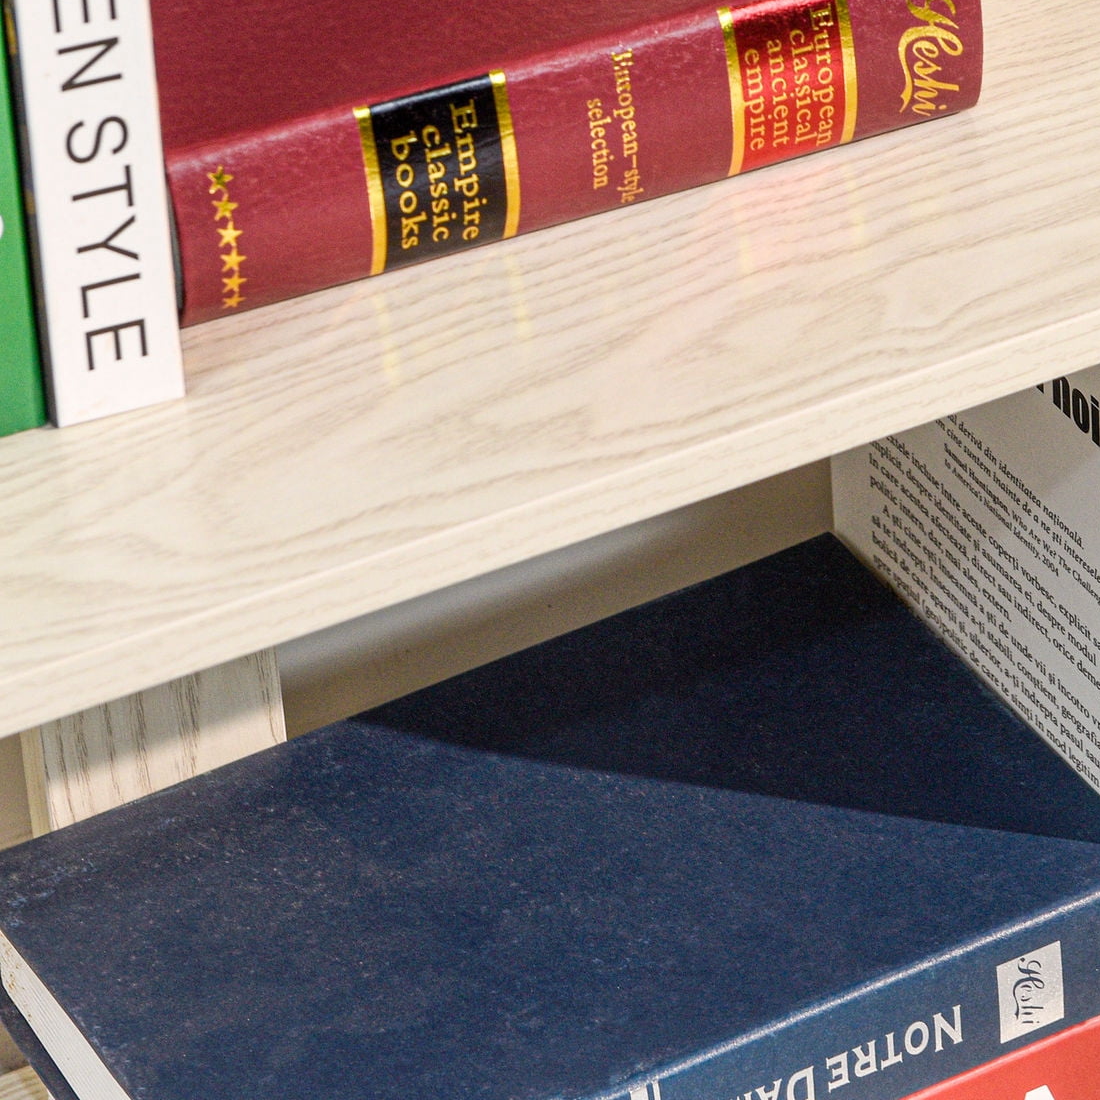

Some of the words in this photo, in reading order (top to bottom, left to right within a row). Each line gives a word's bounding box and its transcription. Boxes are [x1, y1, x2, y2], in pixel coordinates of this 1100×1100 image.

[744, 48, 764, 152] empire
[766, 39, 791, 148] ancient
[789, 29, 816, 144] classical
[809, 5, 834, 147] European
[390, 130, 427, 250] books
[422, 124, 457, 242] classic
[450, 99, 488, 242] Empire
[587, 97, 610, 189] selection
[66, 115, 149, 372] STYLE
[869, 475, 897, 505] politic
[958, 420, 982, 450] derivă
[998, 460, 1041, 508] identitatea
[963, 445, 991, 477] suntem
[880, 466, 898, 487] care
[900, 484, 929, 517] acestea
[971, 554, 996, 587] direct
[1052, 638, 1074, 664] orice
[903, 526, 921, 548] cine
[1010, 635, 1032, 662] unde
[905, 468, 932, 501] despre
[933, 495, 971, 542] identitate
[981, 548, 1022, 594] asumarea
[1036, 600, 1065, 635] despre
[1067, 631, 1096, 666] modul
[961, 508, 987, 538] aceste
[1058, 603, 1091, 641] explicit
[1041, 554, 1058, 577] 2004
[911, 572, 928, 594] care
[1059, 722, 1083, 752] pasul
[981, 664, 999, 686] care
[1068, 746, 1099, 787] legitim
[737, 1066, 815, 1100] DA
[825, 1004, 963, 1093] NOTRE
